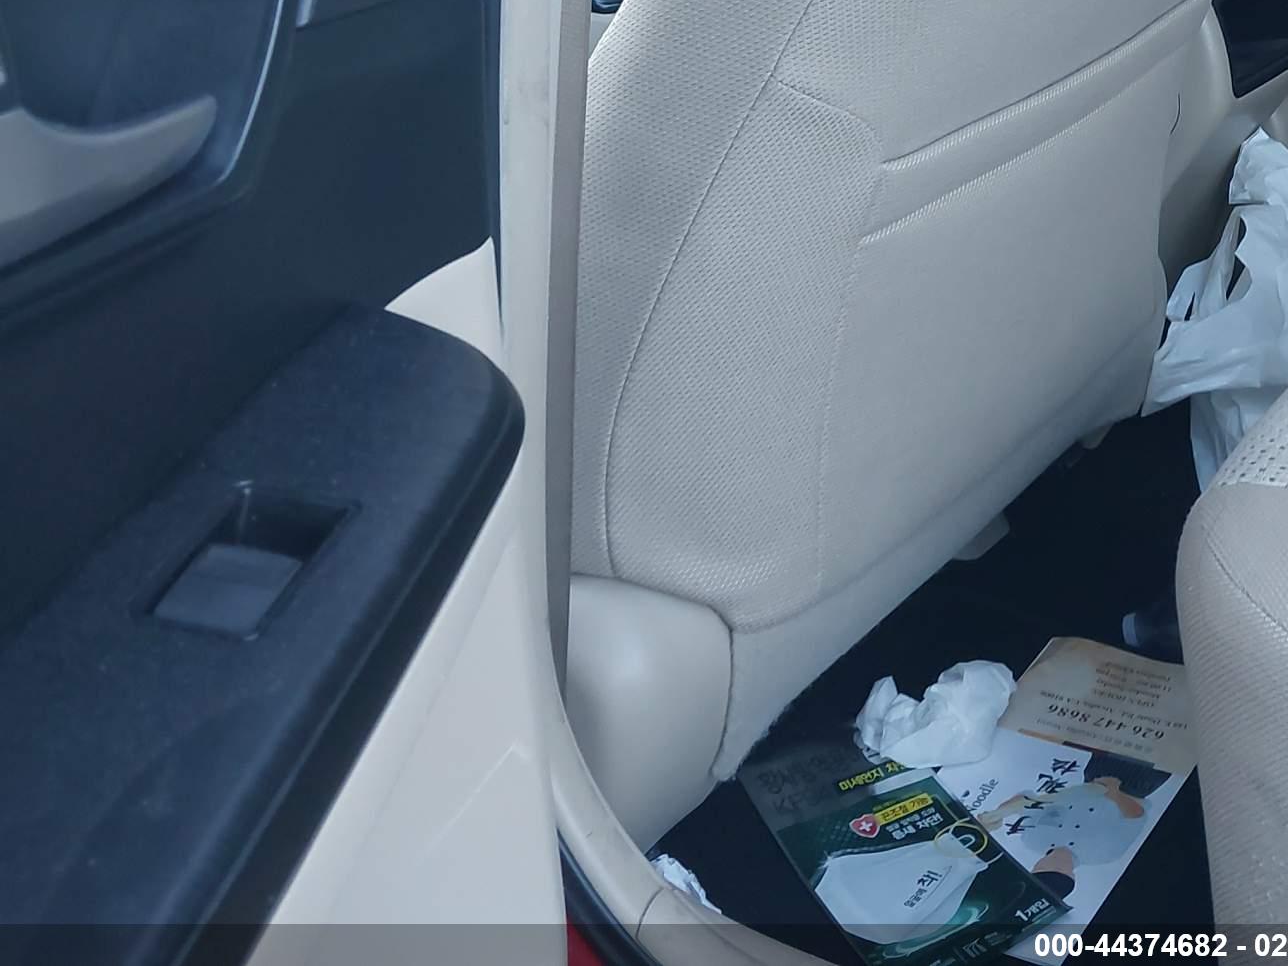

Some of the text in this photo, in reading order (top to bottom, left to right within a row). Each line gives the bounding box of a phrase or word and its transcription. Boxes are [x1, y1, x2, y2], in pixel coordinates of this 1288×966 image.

[1047, 704, 1090, 723] 8686
[1092, 716, 1127, 731] 447
[1131, 724, 1165, 740] 626
